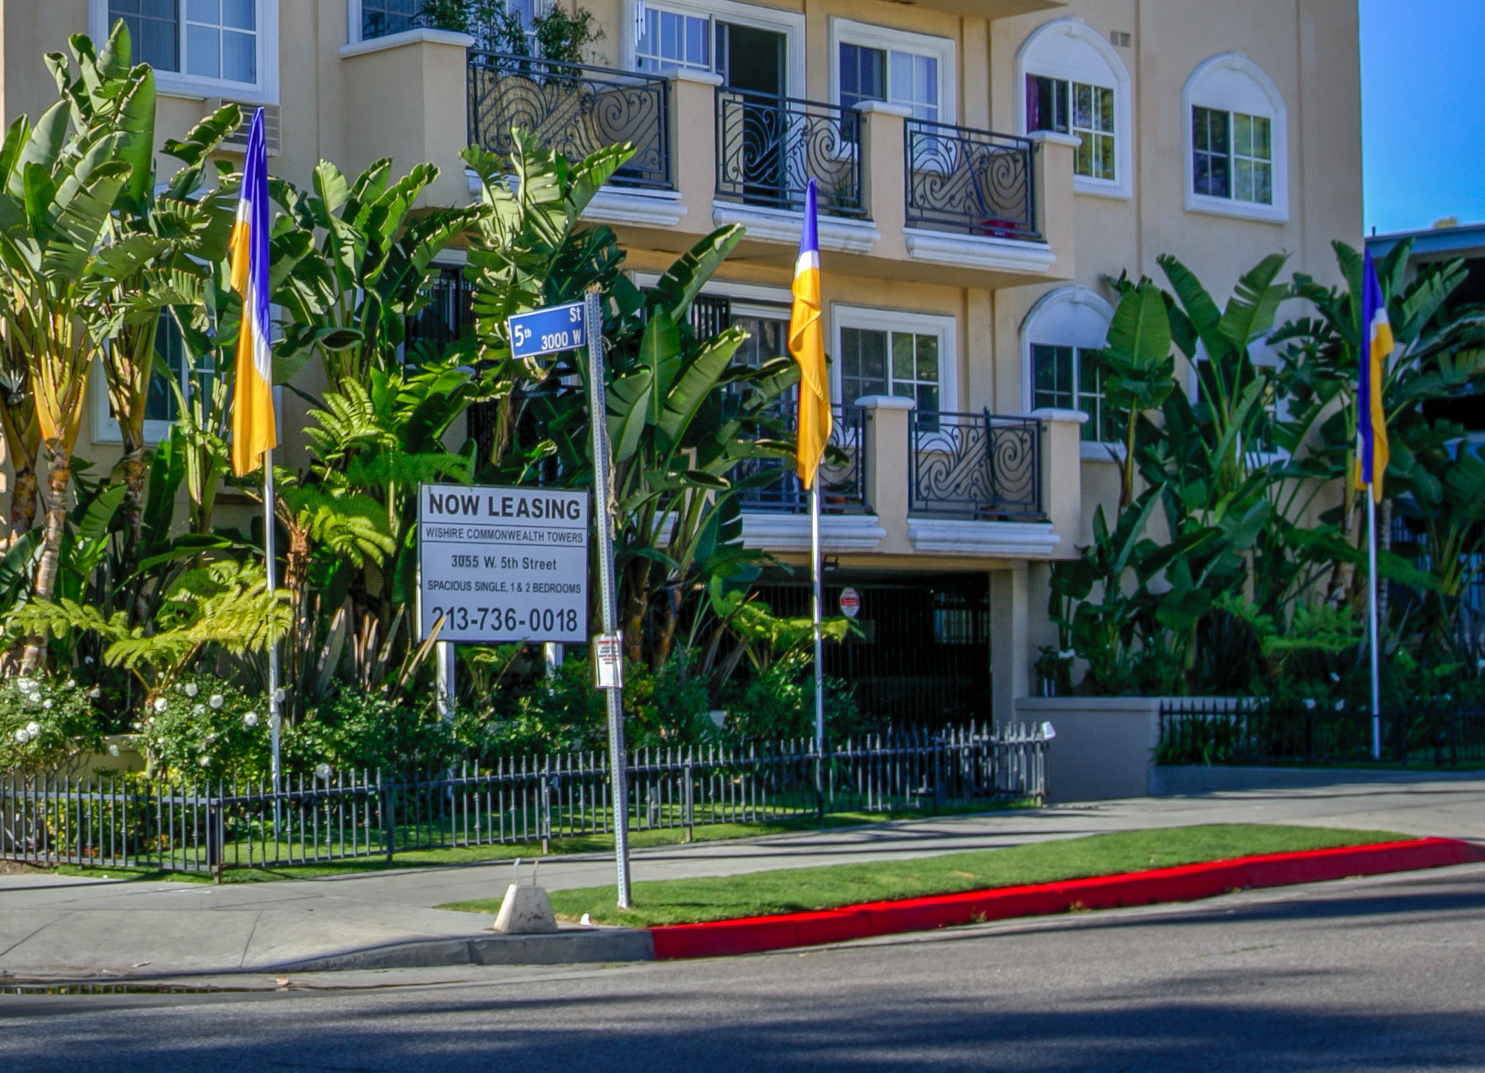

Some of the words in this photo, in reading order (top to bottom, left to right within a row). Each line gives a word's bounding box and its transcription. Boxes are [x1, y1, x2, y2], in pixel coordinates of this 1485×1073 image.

[514, 324, 532, 347] 5th
[569, 307, 581, 323] St
[541, 332, 568, 350] 3000
[572, 329, 581, 344] W
[429, 493, 480, 515] NOW
[488, 496, 581, 520] LEASING
[426, 527, 464, 538] WISHIRE
[467, 528, 545, 542] COMMONWEALTH
[547, 531, 583, 543] TOWERS
[451, 554, 479, 568] 3055
[484, 556, 497, 569] W.
[501, 557, 518, 569] 5th
[522, 558, 557, 571] Street
[427, 580, 472, 591] SPACIOUS
[474, 581, 508, 594] SINGLE,
[510, 582, 515, 592] 1
[516, 582, 523, 592] &
[525, 582, 531, 593] 2
[532, 583, 581, 594] BEDROOMS
